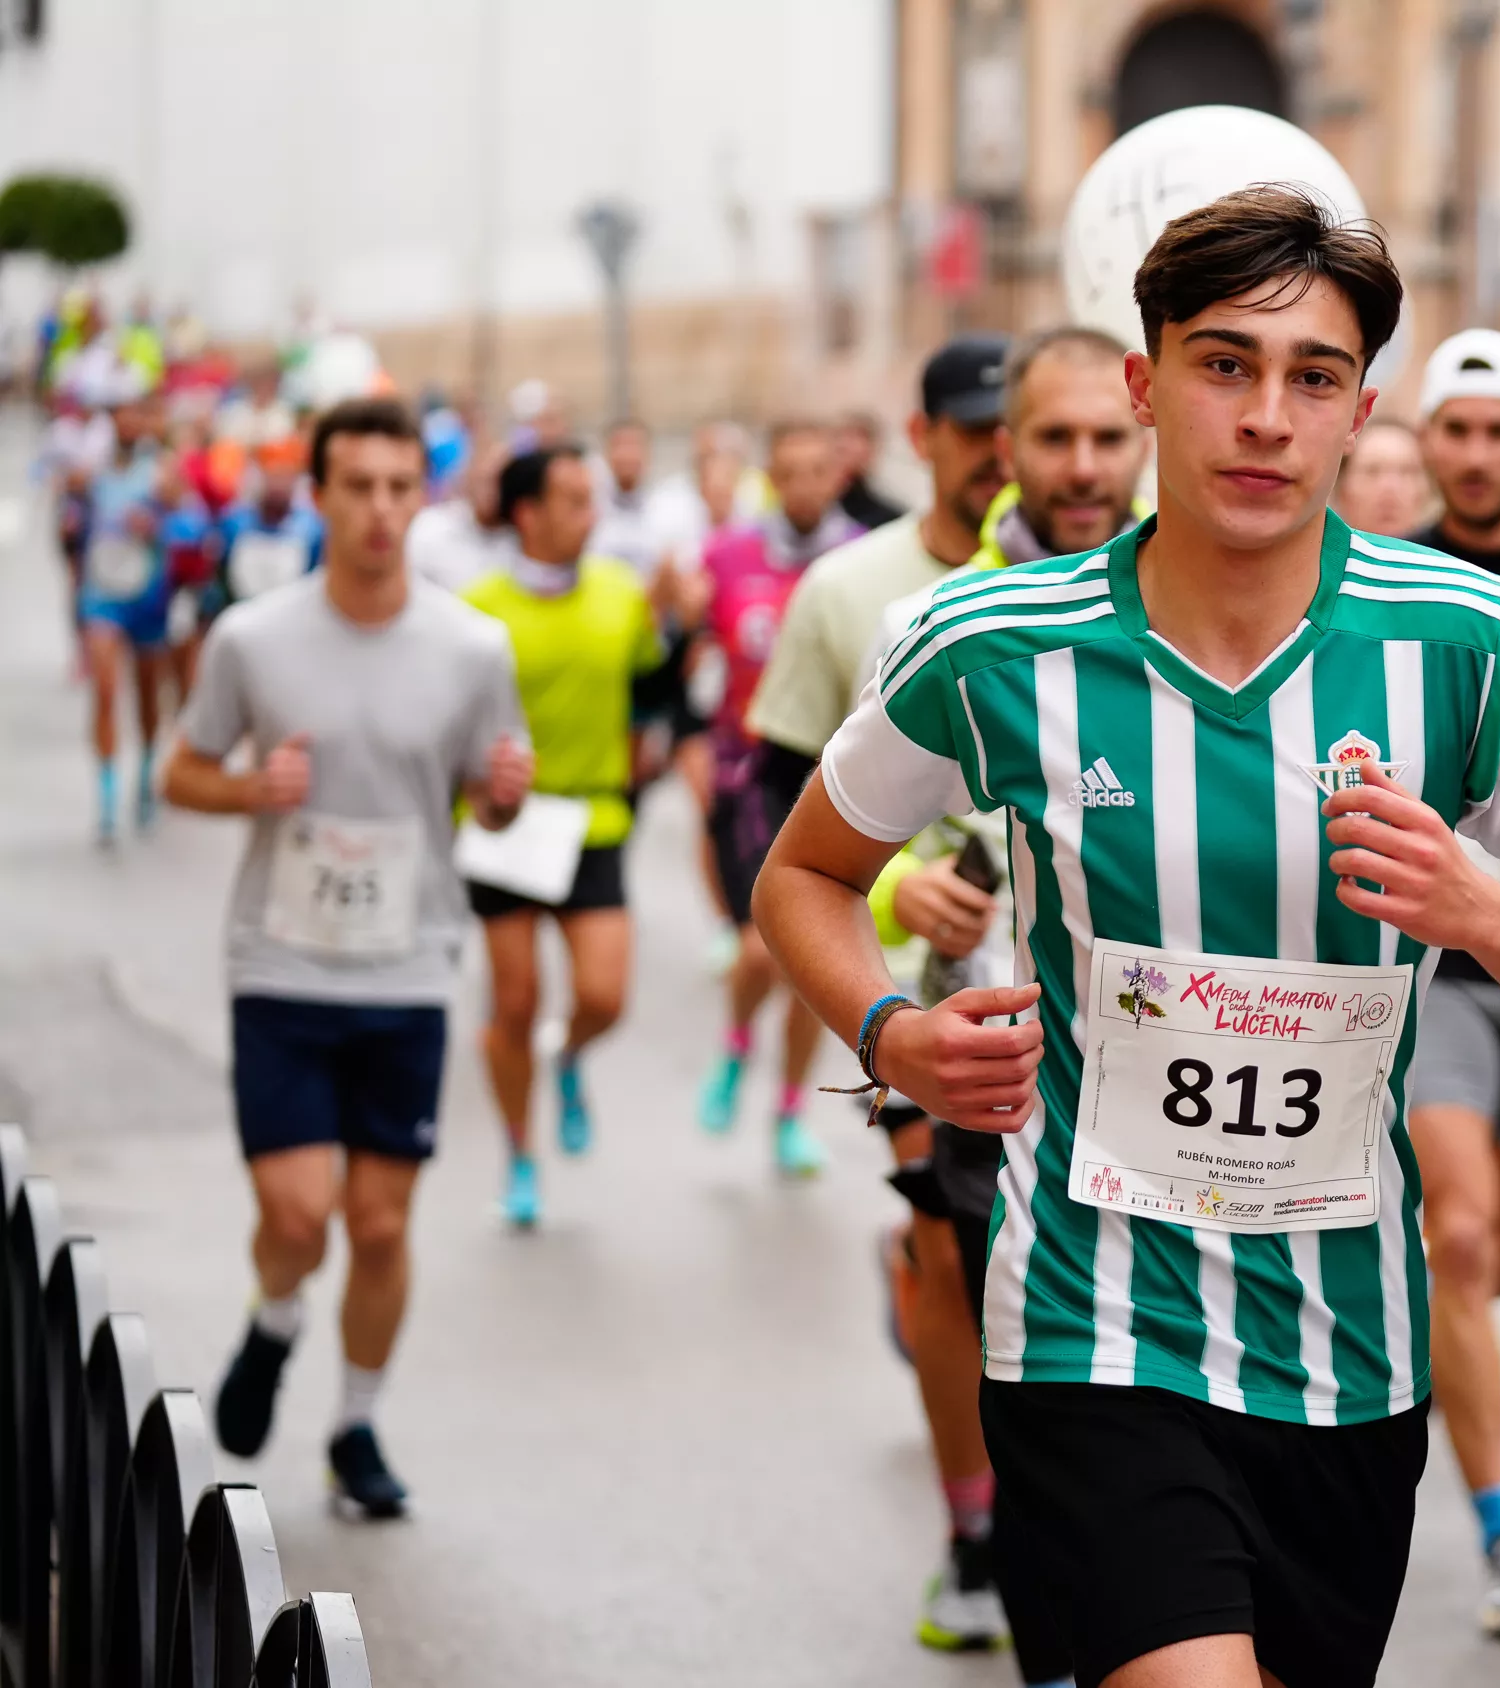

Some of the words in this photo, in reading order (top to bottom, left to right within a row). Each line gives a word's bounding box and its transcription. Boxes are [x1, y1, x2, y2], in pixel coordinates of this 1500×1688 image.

[1068, 788, 1135, 808] adidas
[1214, 1005, 1316, 1040] LUCENA
[1163, 1058, 1322, 1138] 813
[1177, 1149, 1213, 1164] RUBÉN
[1216, 1156, 1264, 1170] ROMERO
[1266, 1159, 1296, 1171] ROJAS
[1208, 1170, 1265, 1185] M-Hombre
[1273, 1205, 1327, 1216] #mediamaratonlucena
[1274, 1193, 1367, 1209] mediamaratonlucena.com
